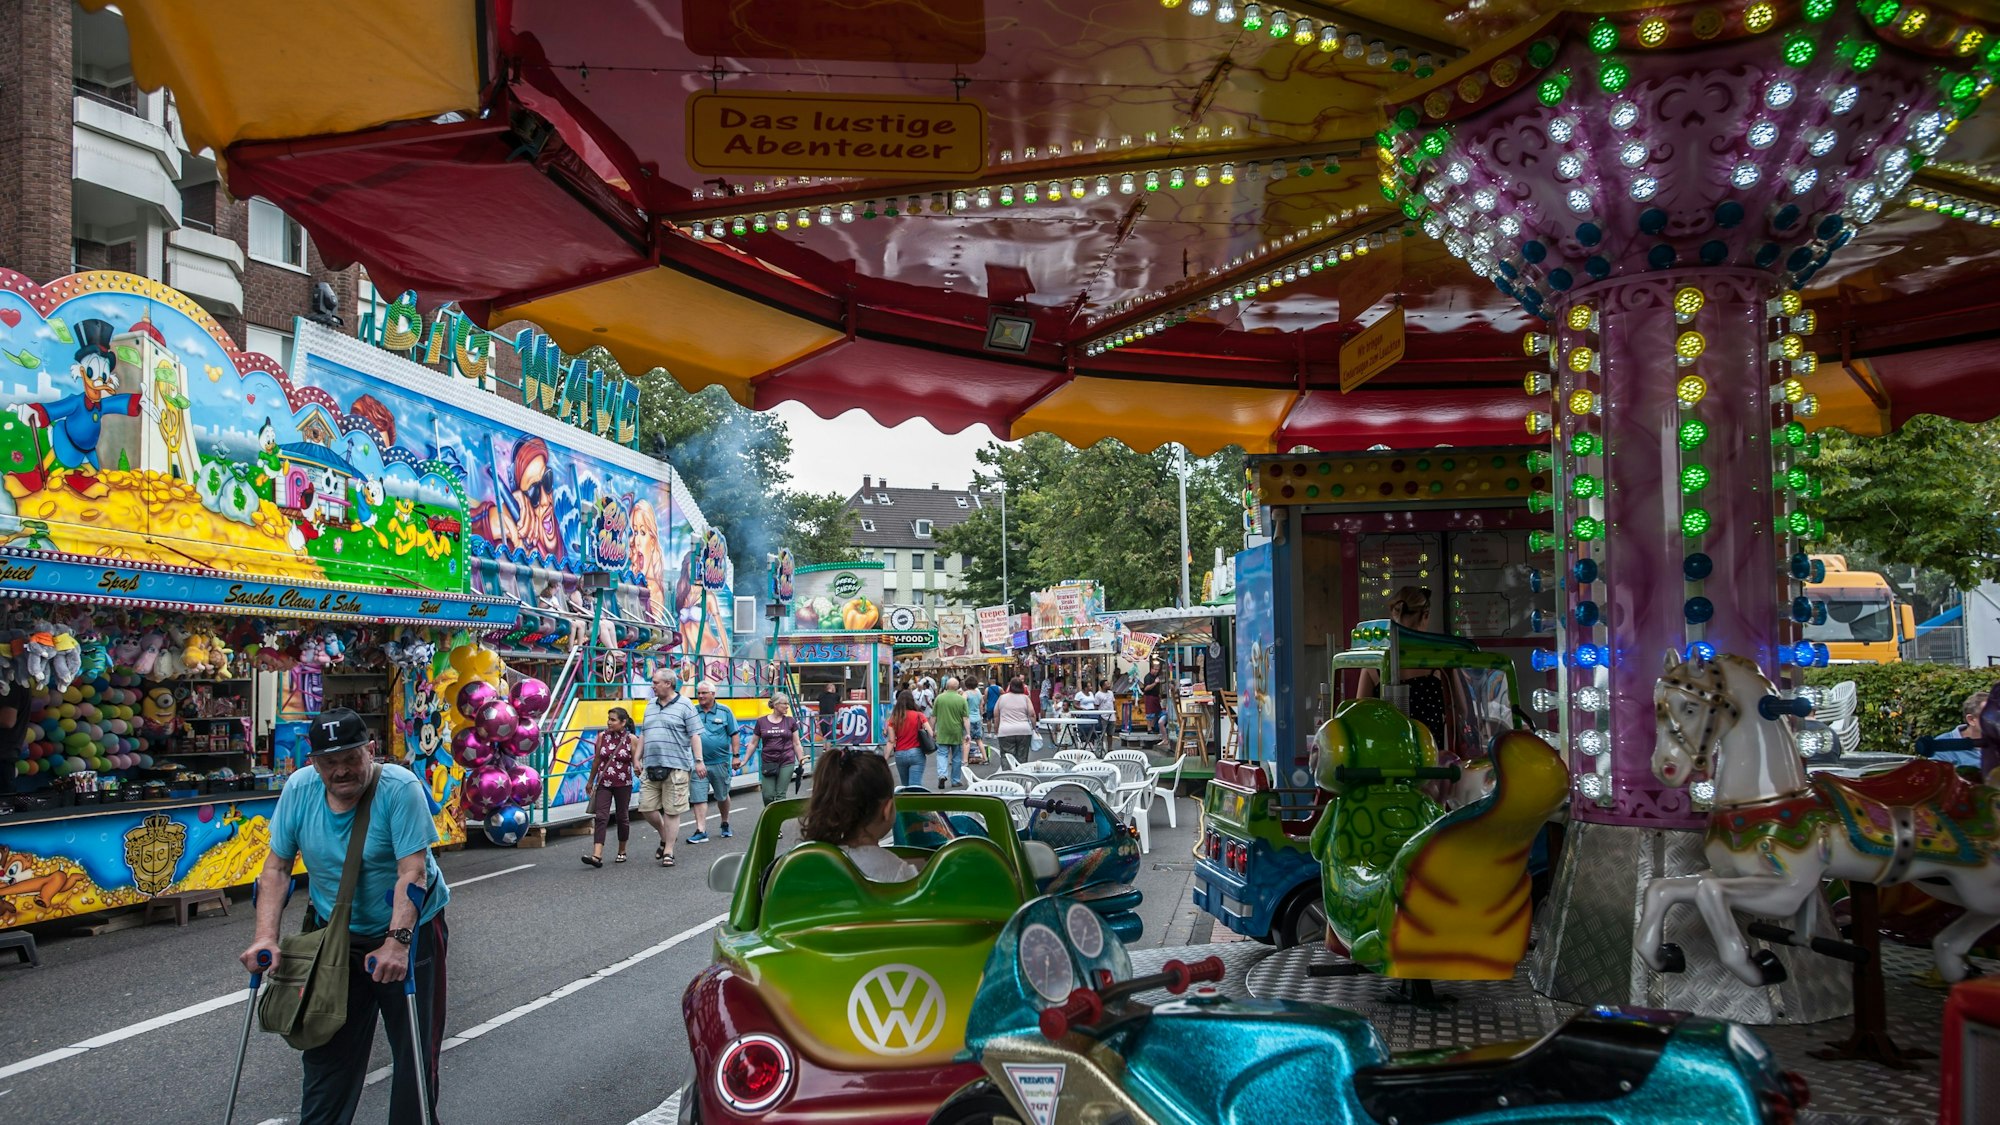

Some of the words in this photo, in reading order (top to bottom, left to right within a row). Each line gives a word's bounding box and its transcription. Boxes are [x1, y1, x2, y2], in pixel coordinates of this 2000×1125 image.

[720, 107, 798, 130] Das
[813, 111, 957, 138] lustige
[723, 134, 954, 159] Abenteuer
[515, 327, 640, 444] WAVE
[835, 577, 858, 586] GREEN
[835, 585, 861, 595] ENERGY
[98, 569, 140, 592] Spaß
[224, 584, 274, 606] Sascha
[278, 588, 316, 609] Claus
[319, 593, 332, 610] &
[331, 594, 362, 613] Sohn
[418, 600, 441, 616] Spiel
[467, 603, 489, 618] Spaß
[894, 635, 924, 643] Y-FOOD
[794, 644, 857, 659] KASSE
[322, 721, 340, 741] T
[1019, 1076, 1055, 1084] PREDATOR
